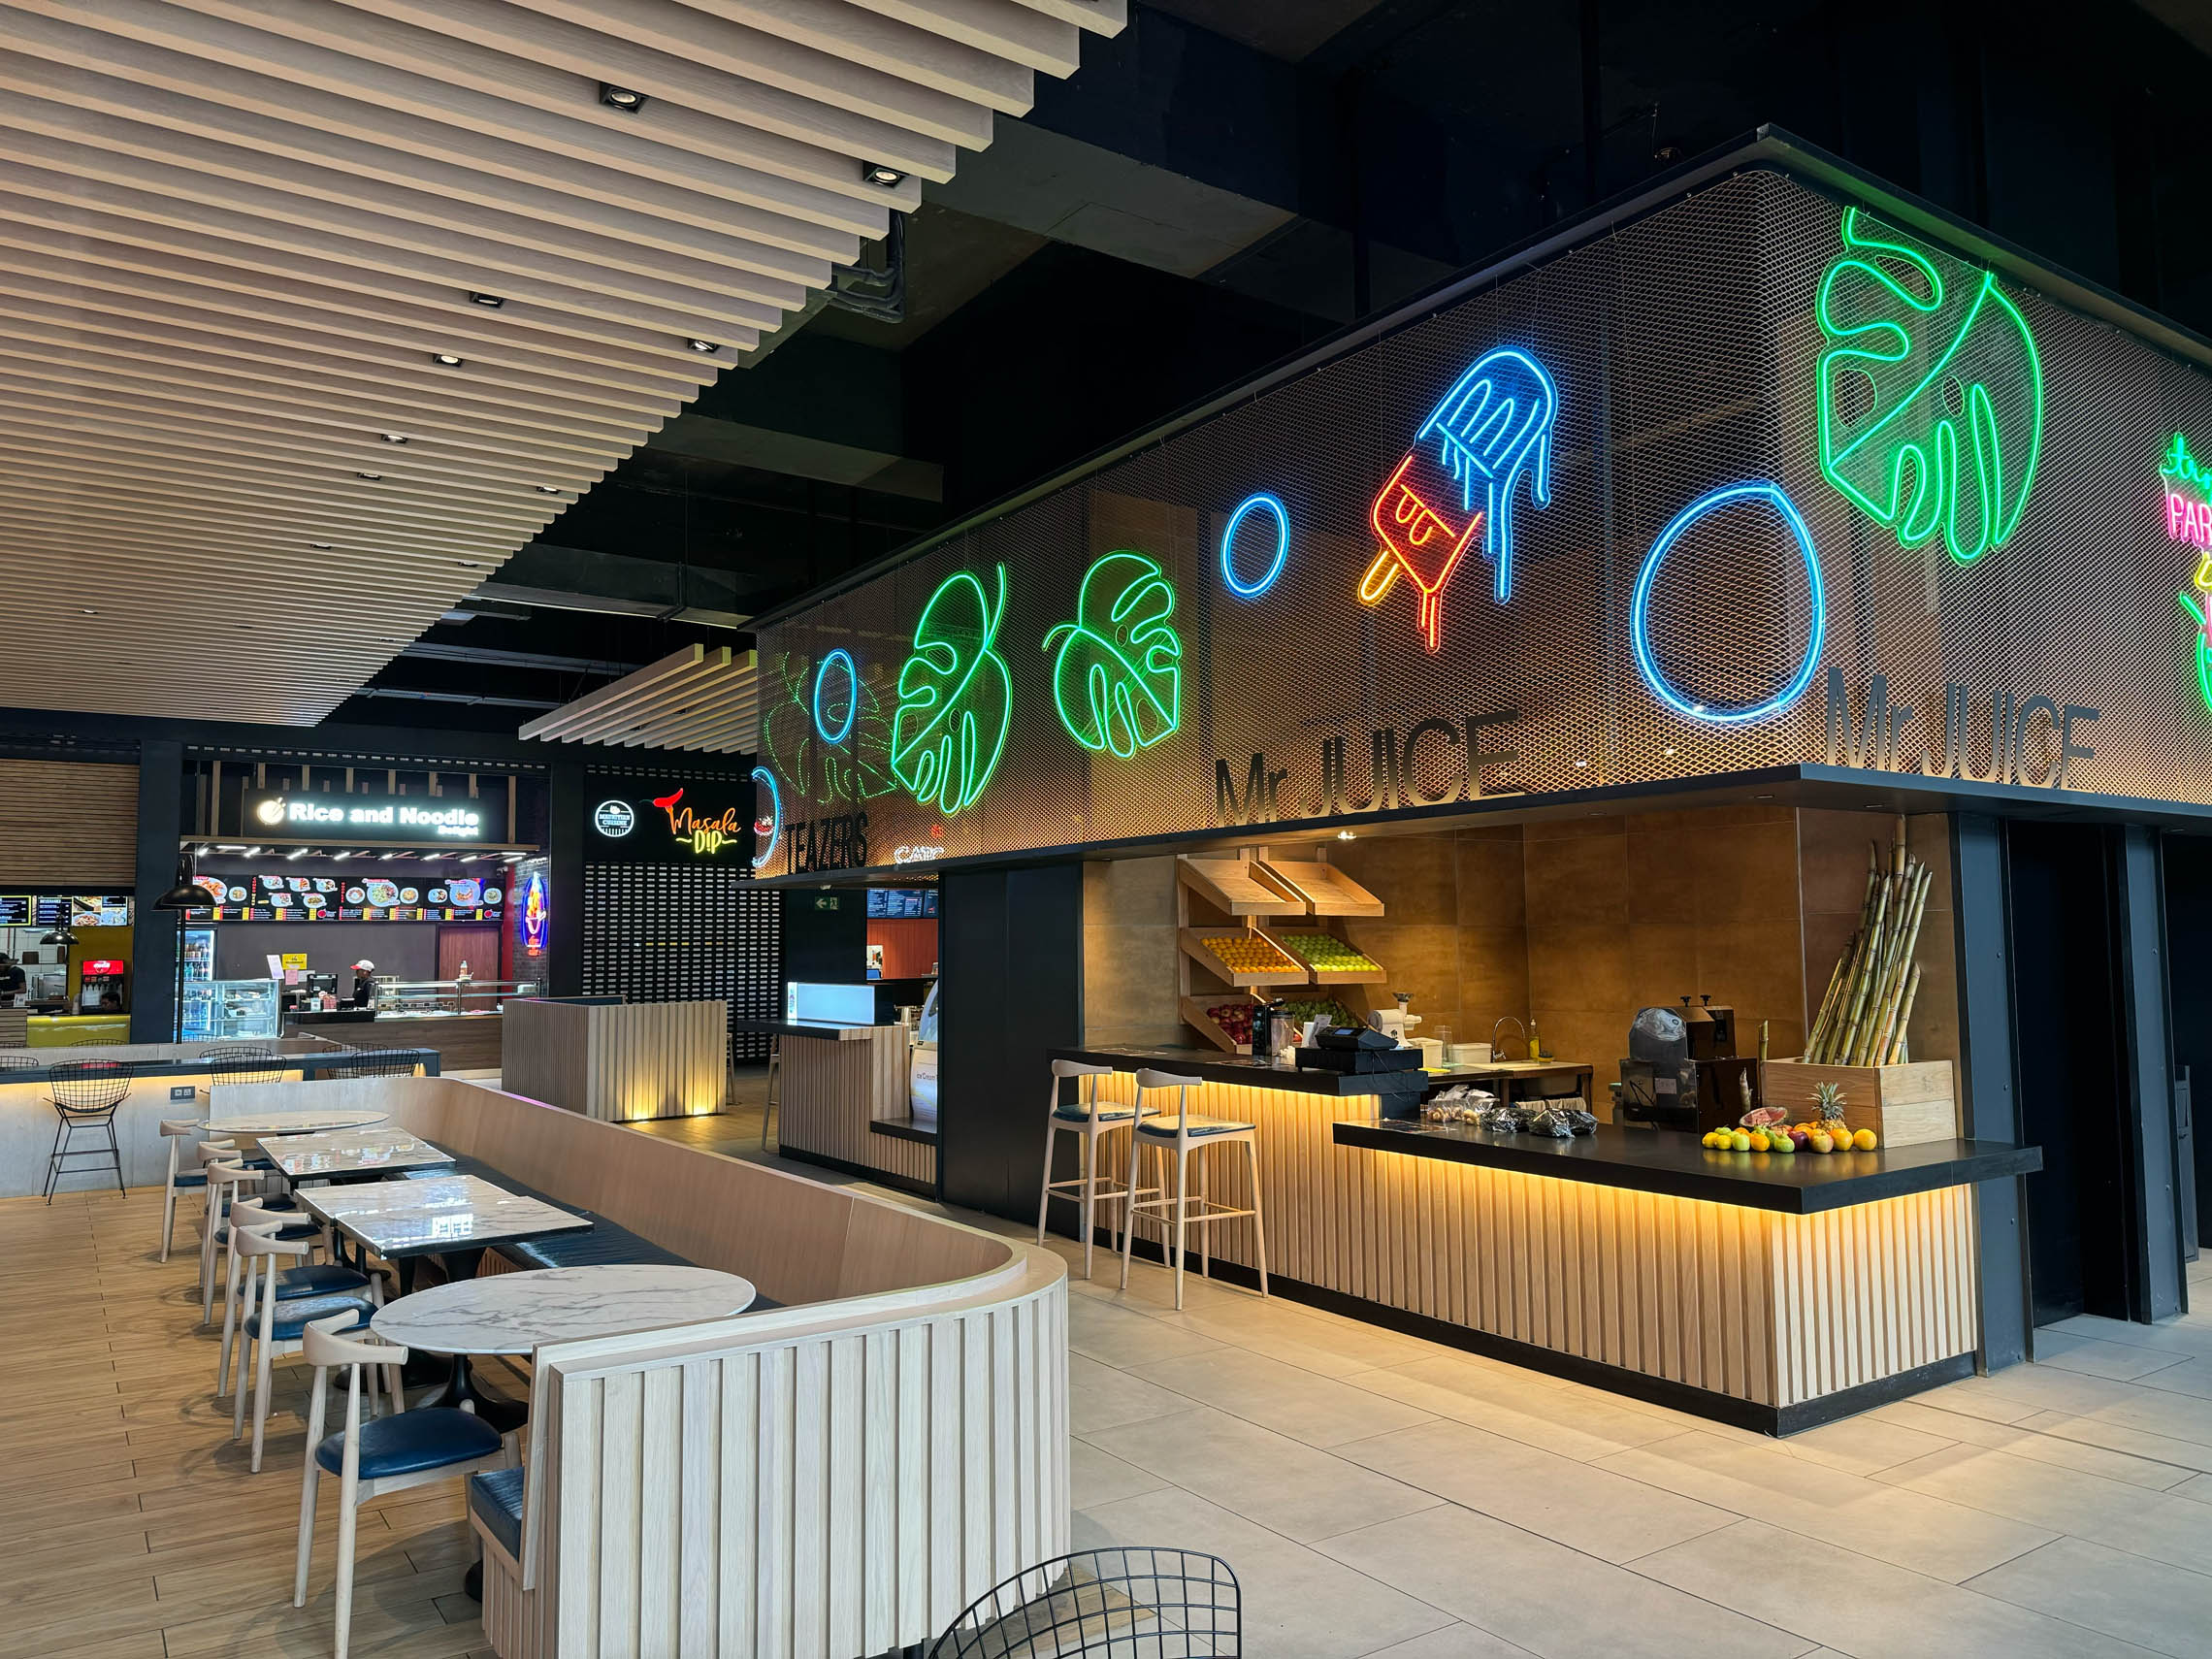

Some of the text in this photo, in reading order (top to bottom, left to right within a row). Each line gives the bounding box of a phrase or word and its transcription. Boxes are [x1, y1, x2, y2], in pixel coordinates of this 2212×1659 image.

[1826, 667, 2100, 794] Mr JUICE
[1215, 708, 1526, 829] Mr JUICE
[288, 802, 479, 826] Rice and Noodle
[667, 806, 742, 836] Masala
[784, 811, 868, 875] TEAZERS
